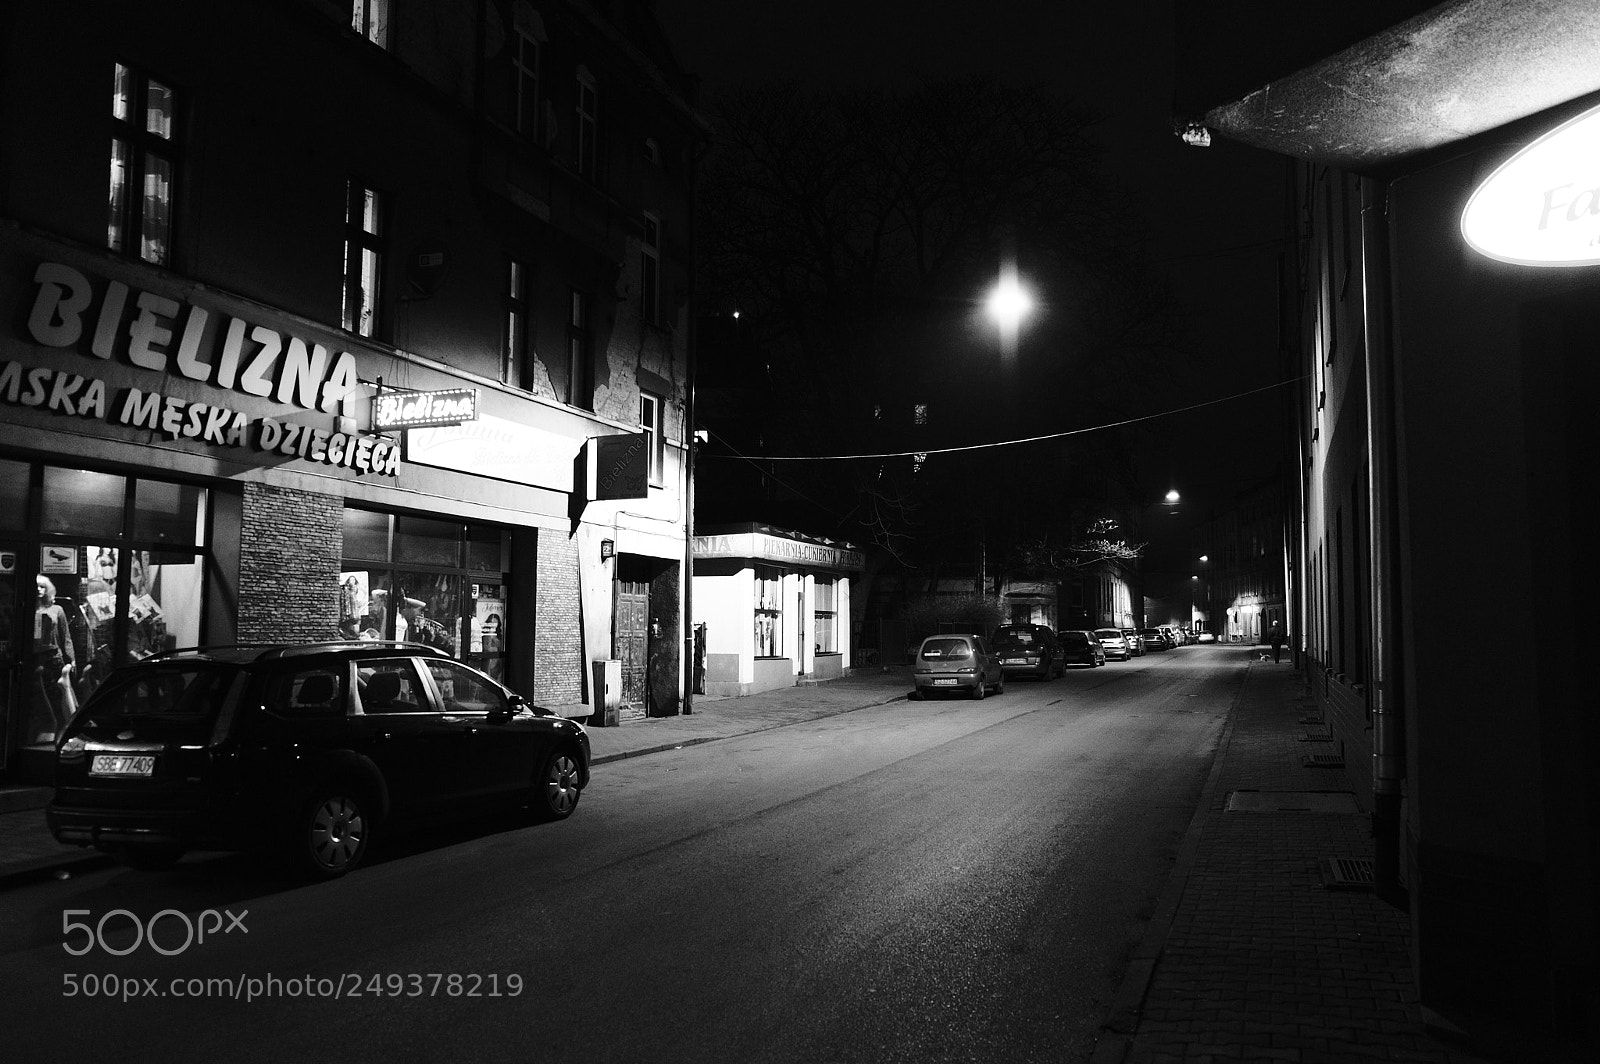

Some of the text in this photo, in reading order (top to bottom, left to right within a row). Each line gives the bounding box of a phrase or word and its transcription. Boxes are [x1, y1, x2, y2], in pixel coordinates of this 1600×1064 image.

[28, 262, 356, 417] BIELIZNA
[120, 388, 247, 446] MĘSKA
[260, 417, 400, 476] DZIECIĘCA
[379, 395, 472, 427] Bielizna
[600, 437, 644, 490] Bielizna
[97, 756, 153, 772] SBE 77409
